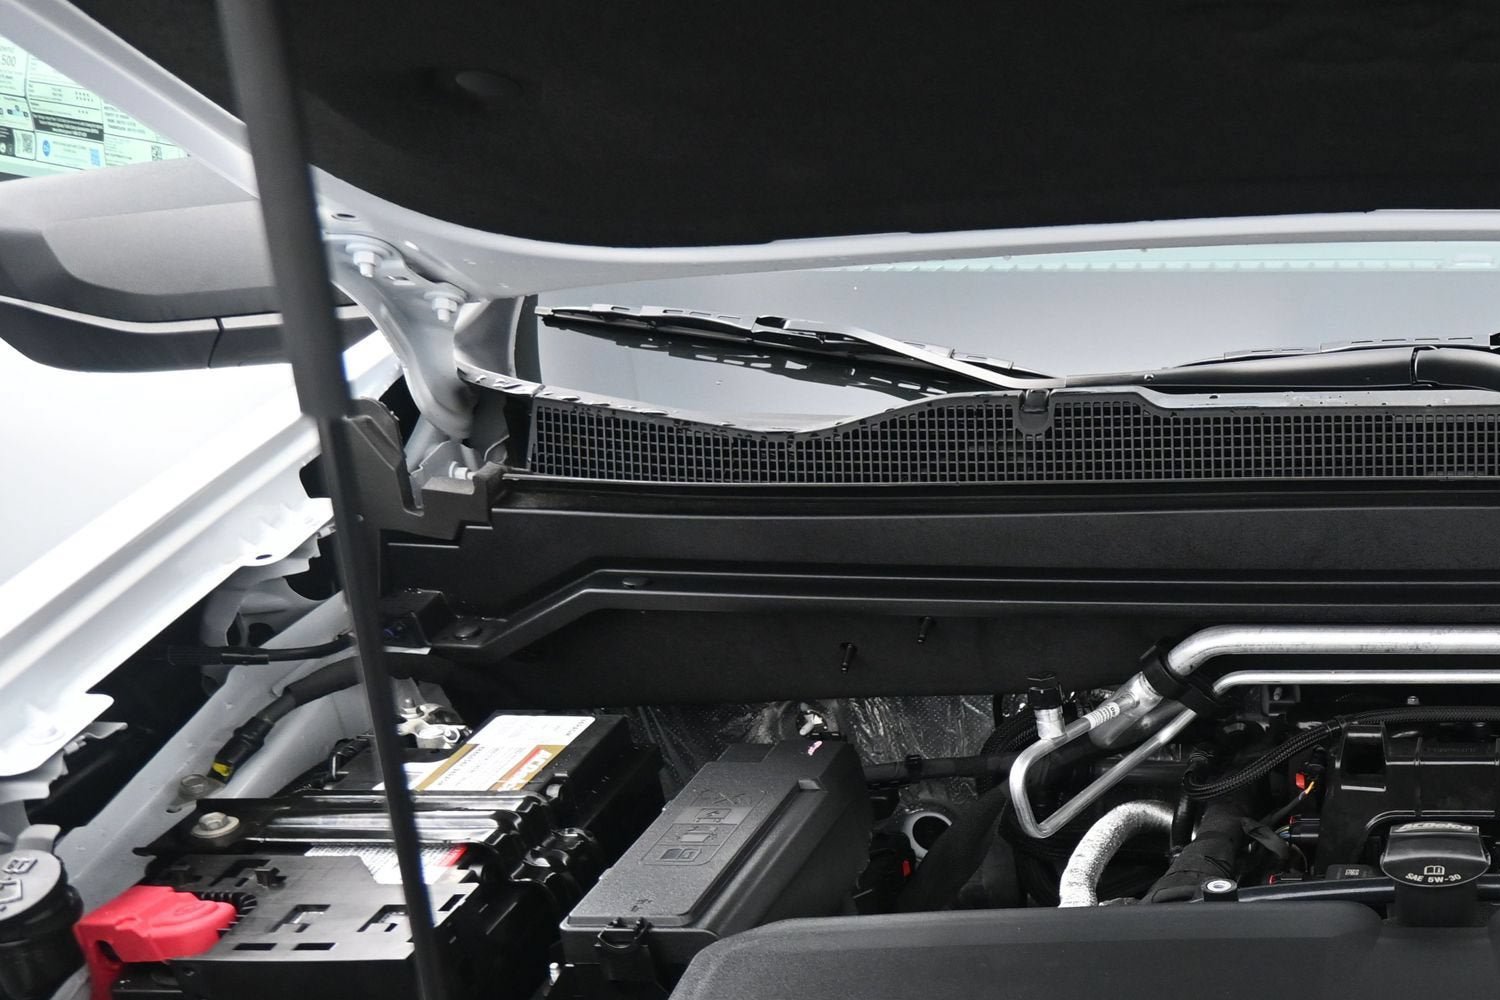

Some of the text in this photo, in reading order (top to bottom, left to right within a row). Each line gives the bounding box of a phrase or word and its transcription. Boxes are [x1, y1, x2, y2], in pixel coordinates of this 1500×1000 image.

[1395, 823, 1473, 832] ACDelco
[1405, 873, 1461, 883] SAE 5W-30
